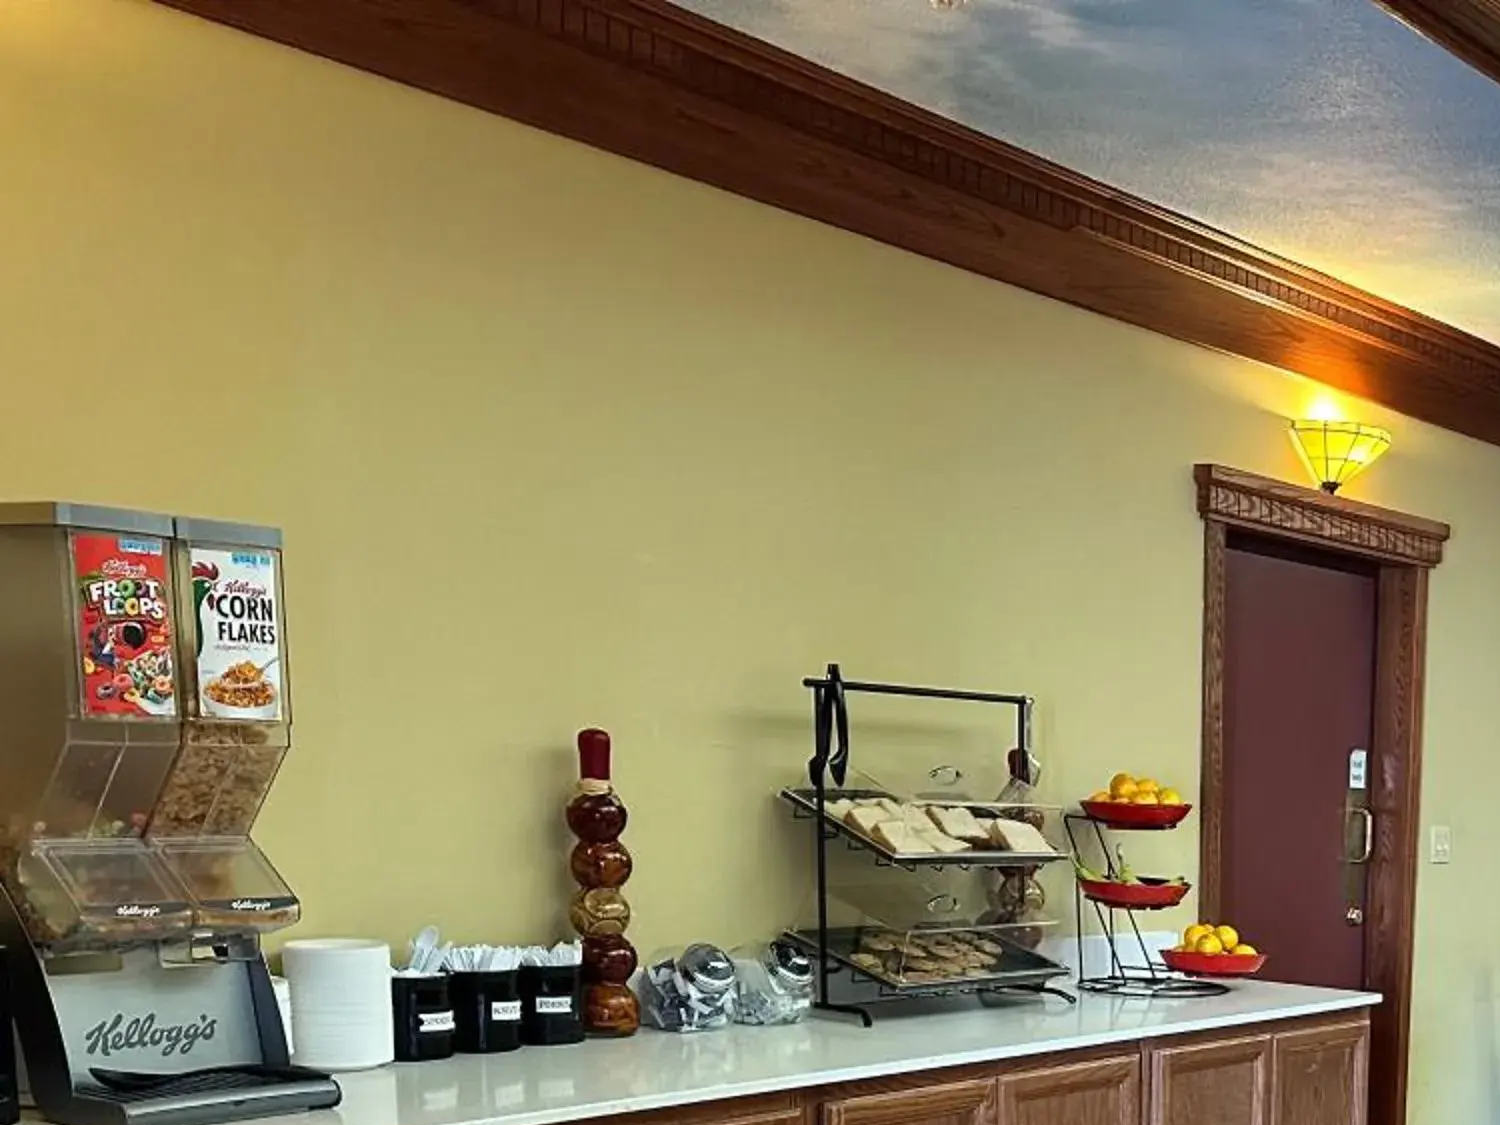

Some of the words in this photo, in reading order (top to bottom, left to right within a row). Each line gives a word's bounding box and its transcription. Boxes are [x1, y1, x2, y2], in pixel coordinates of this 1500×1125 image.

[89, 580, 159, 602] FROOT
[103, 598, 164, 619] LOOPS
[216, 594, 273, 622] CORN
[218, 621, 276, 645] FLAKES
[85, 1012, 218, 1057] Kellogg's
